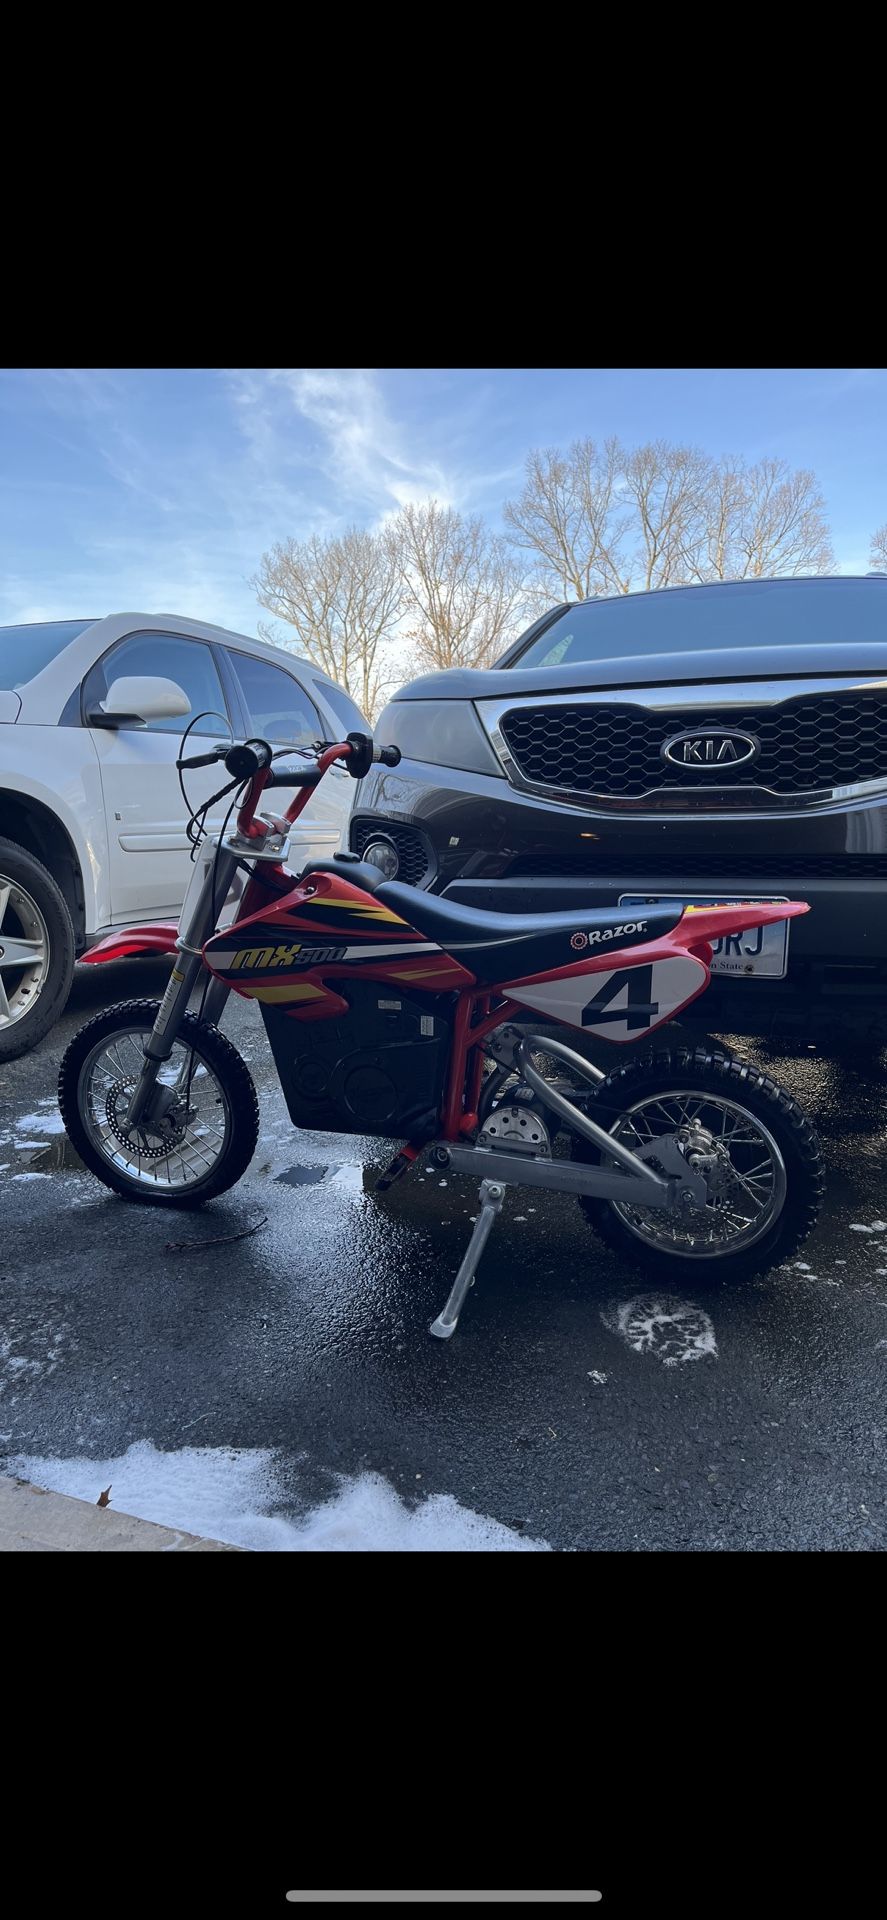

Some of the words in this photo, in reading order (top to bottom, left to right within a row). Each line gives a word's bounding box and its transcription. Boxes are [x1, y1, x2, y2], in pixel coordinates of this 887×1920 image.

[683, 740, 738, 761] KIA
[588, 920, 647, 945] Razor
[720, 961, 743, 970] State
[581, 964, 659, 1031] 4
